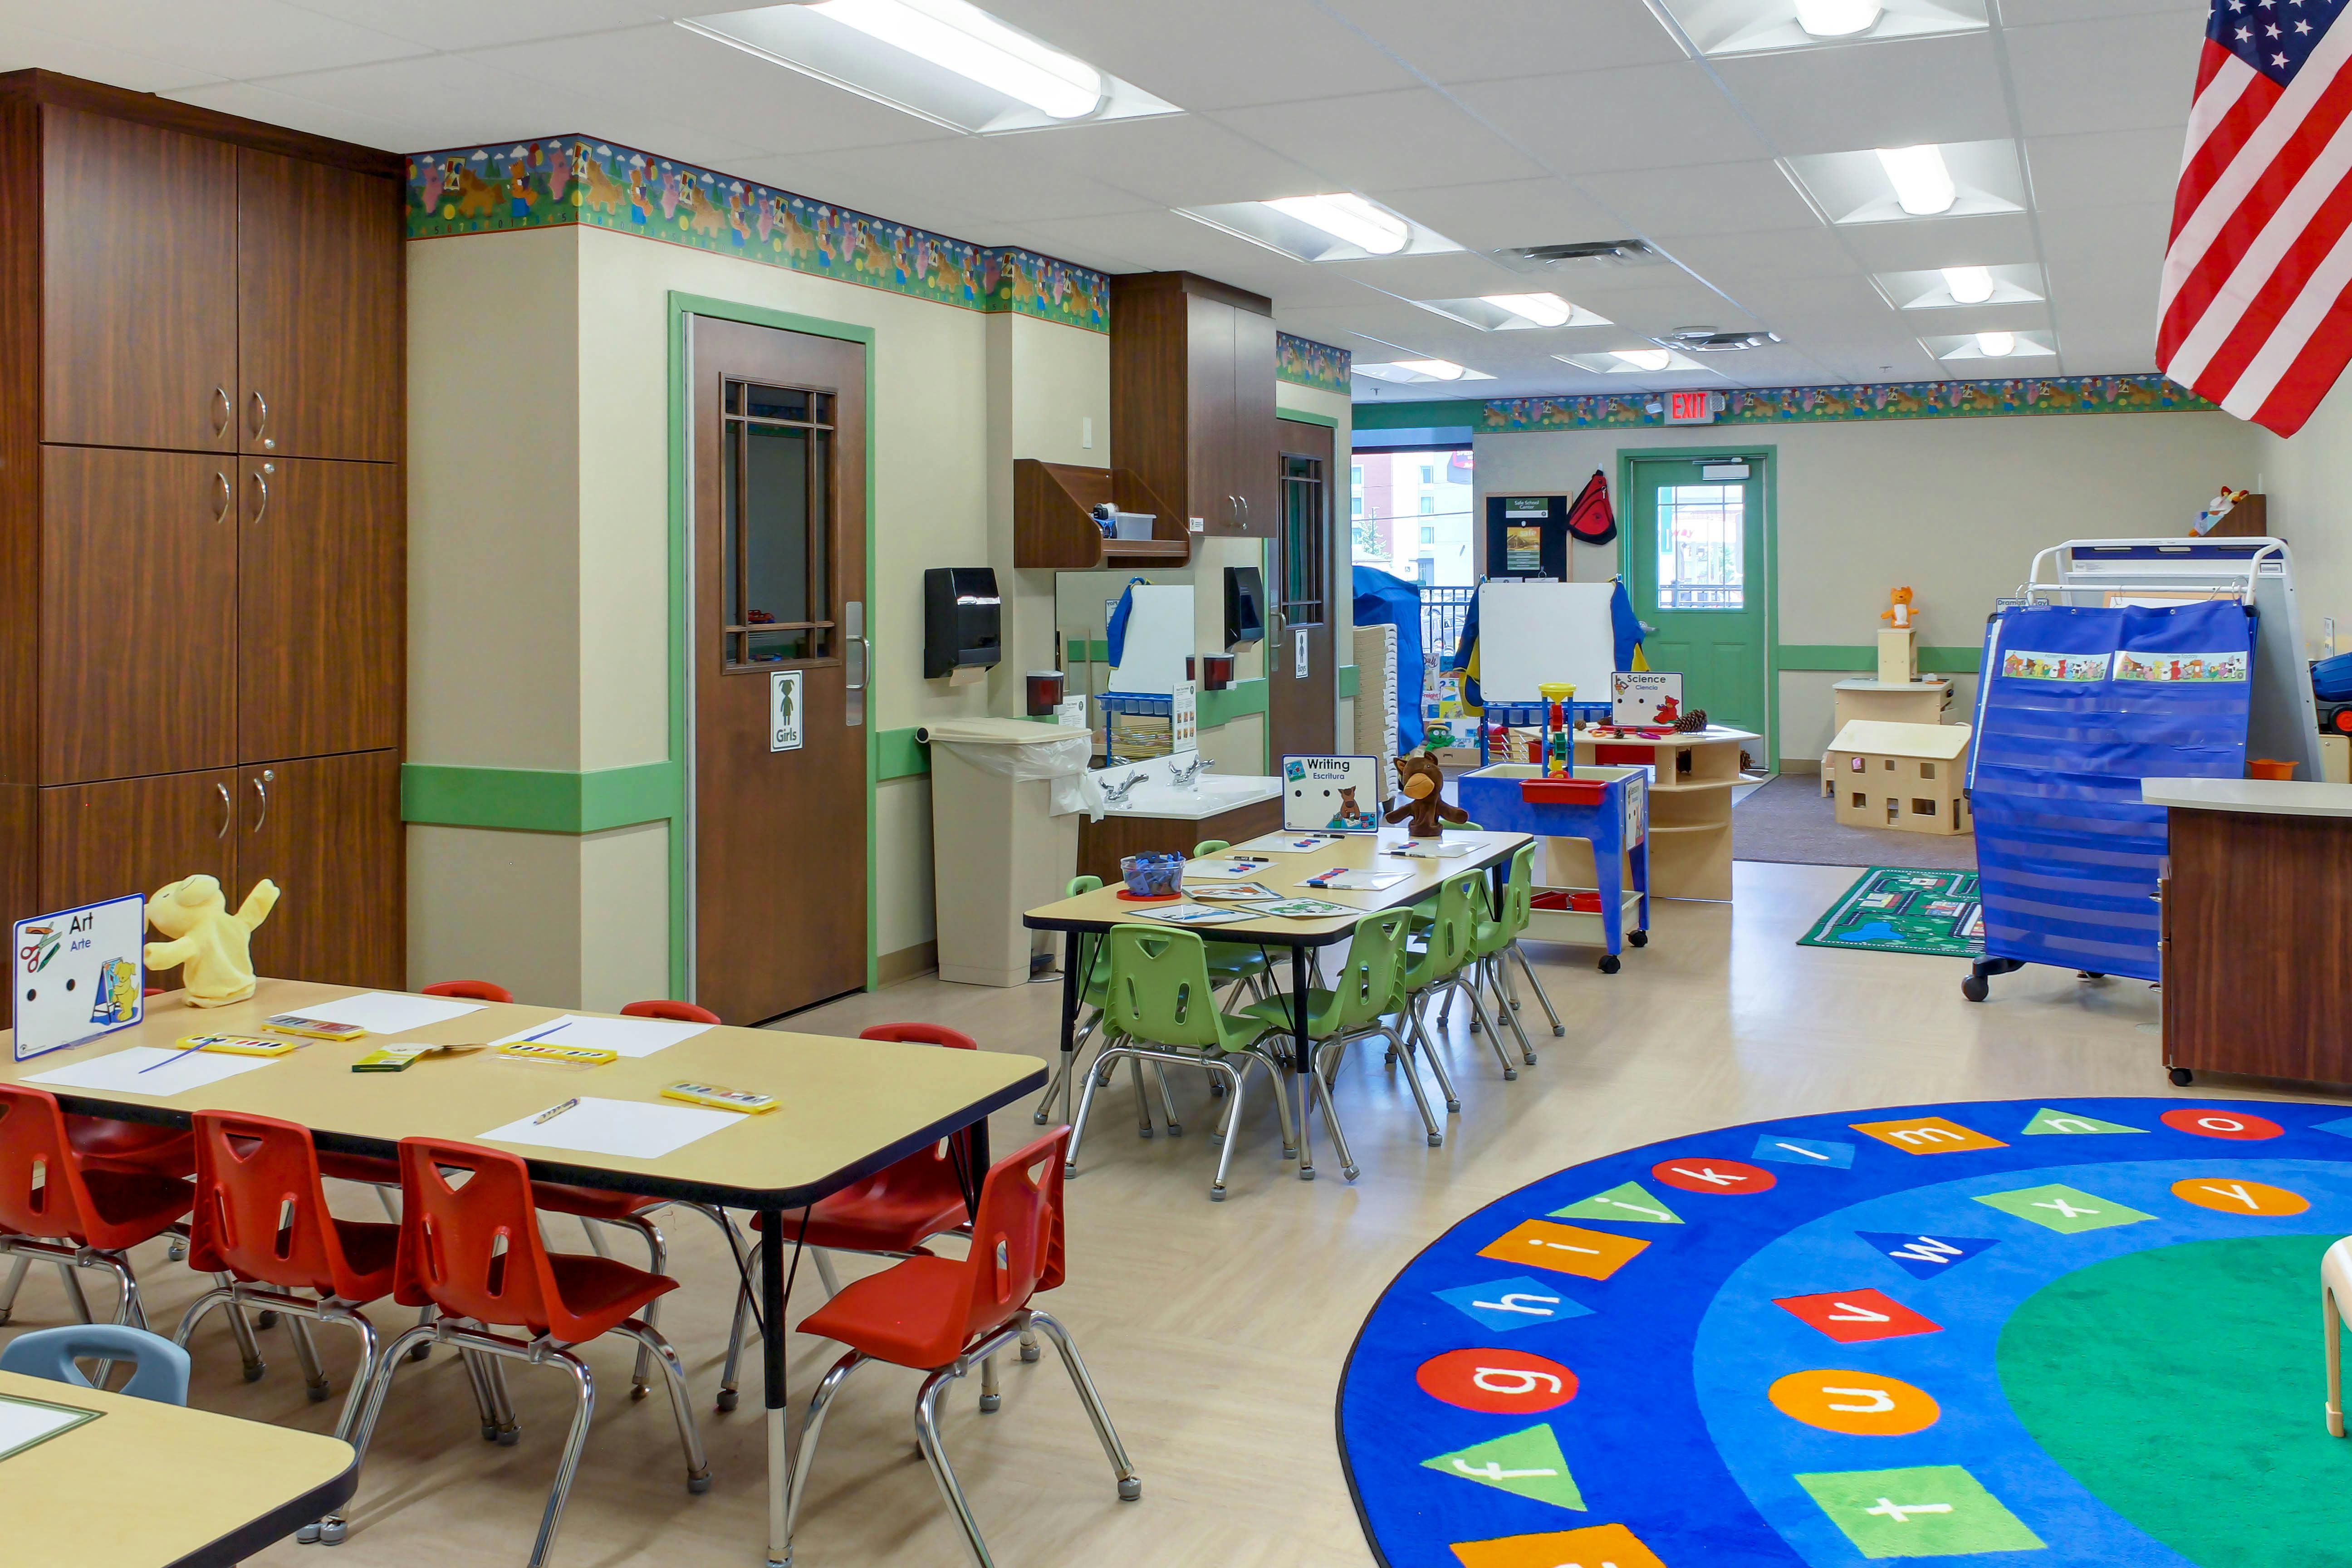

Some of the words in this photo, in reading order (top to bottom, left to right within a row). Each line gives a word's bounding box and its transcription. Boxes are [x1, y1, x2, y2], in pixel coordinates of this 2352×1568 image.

[1672, 393, 1707, 418] EXIT
[1298, 664, 1306, 674] Boys
[1627, 675, 1666, 683] Science
[776, 727, 797, 743] Girls
[1307, 759, 1350, 772] Writing
[69, 912, 93, 935] Art
[70, 938, 91, 952] Arte
[2043, 1117, 2099, 1132] n
[2197, 1117, 2244, 1132] o
[1887, 1127, 1965, 1145] m
[1774, 1142, 1829, 1161] l
[1671, 1167, 1748, 1186] k
[2200, 1184, 2260, 1210] y
[1593, 1197, 1671, 1221] j
[2029, 1198, 2102, 1218] x
[1528, 1239, 1600, 1255] i
[1888, 1235, 1964, 1264] w
[1471, 1293, 1561, 1316] h
[1828, 1302, 1891, 1322] v
[1473, 1367, 1562, 1395] g
[1822, 1387, 1896, 1412] u
[1451, 1458, 1559, 1481] f
[1863, 1497, 1954, 1523] t
